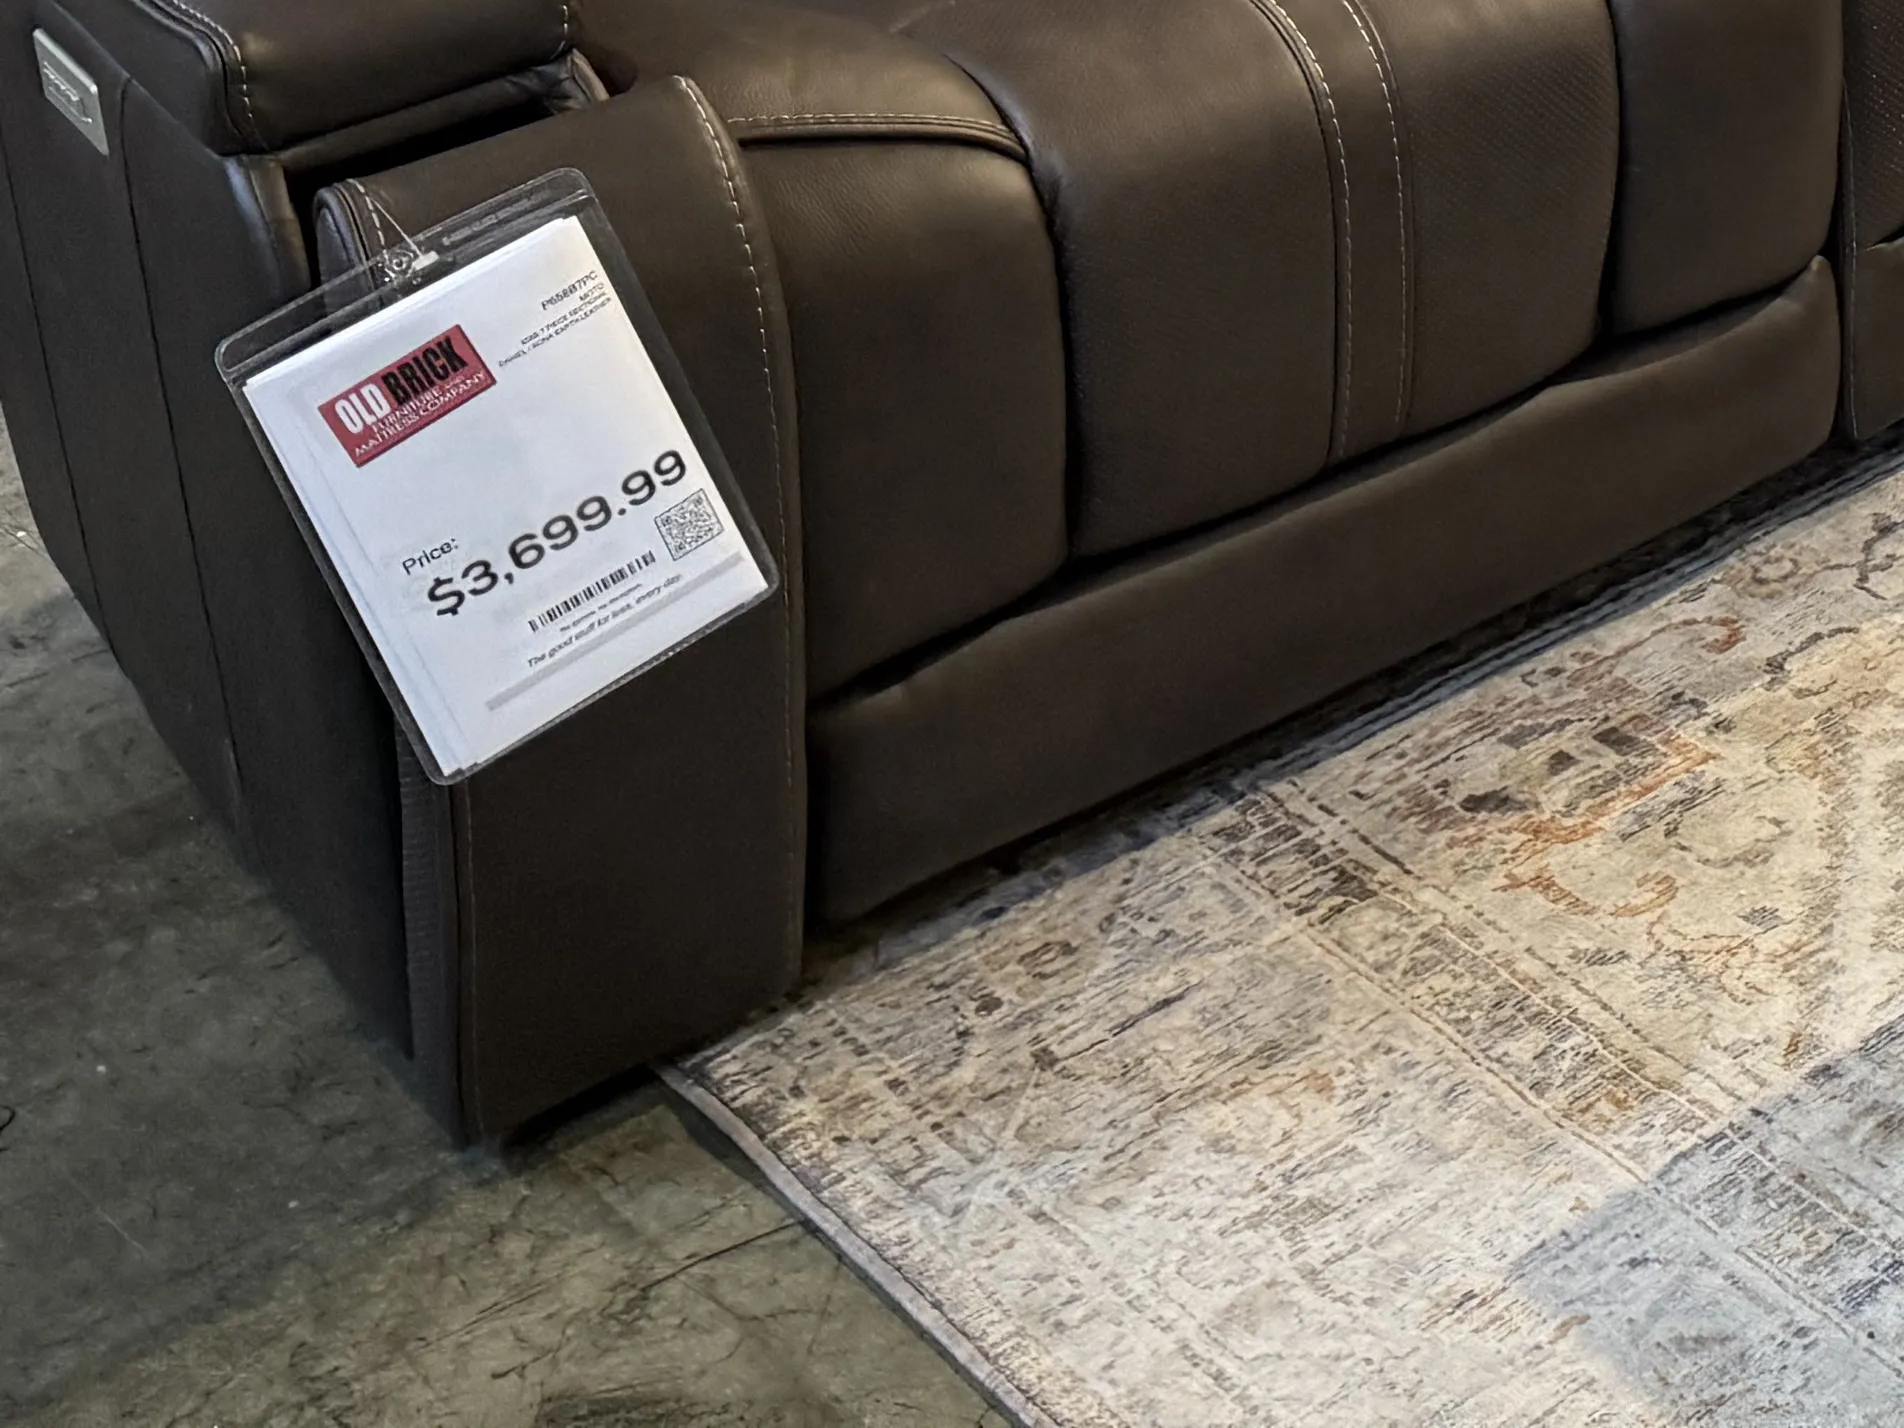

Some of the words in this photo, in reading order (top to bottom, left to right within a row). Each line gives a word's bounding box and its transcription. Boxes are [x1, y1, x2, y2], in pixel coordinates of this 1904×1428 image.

[335, 383, 392, 434] OLD
[381, 337, 469, 406] BRICK
[355, 414, 419, 457] MATTRESS
[419, 370, 487, 416] COMPANY
[371, 385, 443, 432] FURNITURE
[402, 538, 460, 575] Price:
[427, 450, 687, 616] $3,699.99
[527, 653, 547, 667] The
[548, 636, 573, 659] good
[597, 614, 610, 627] for
[635, 585, 662, 605] every
